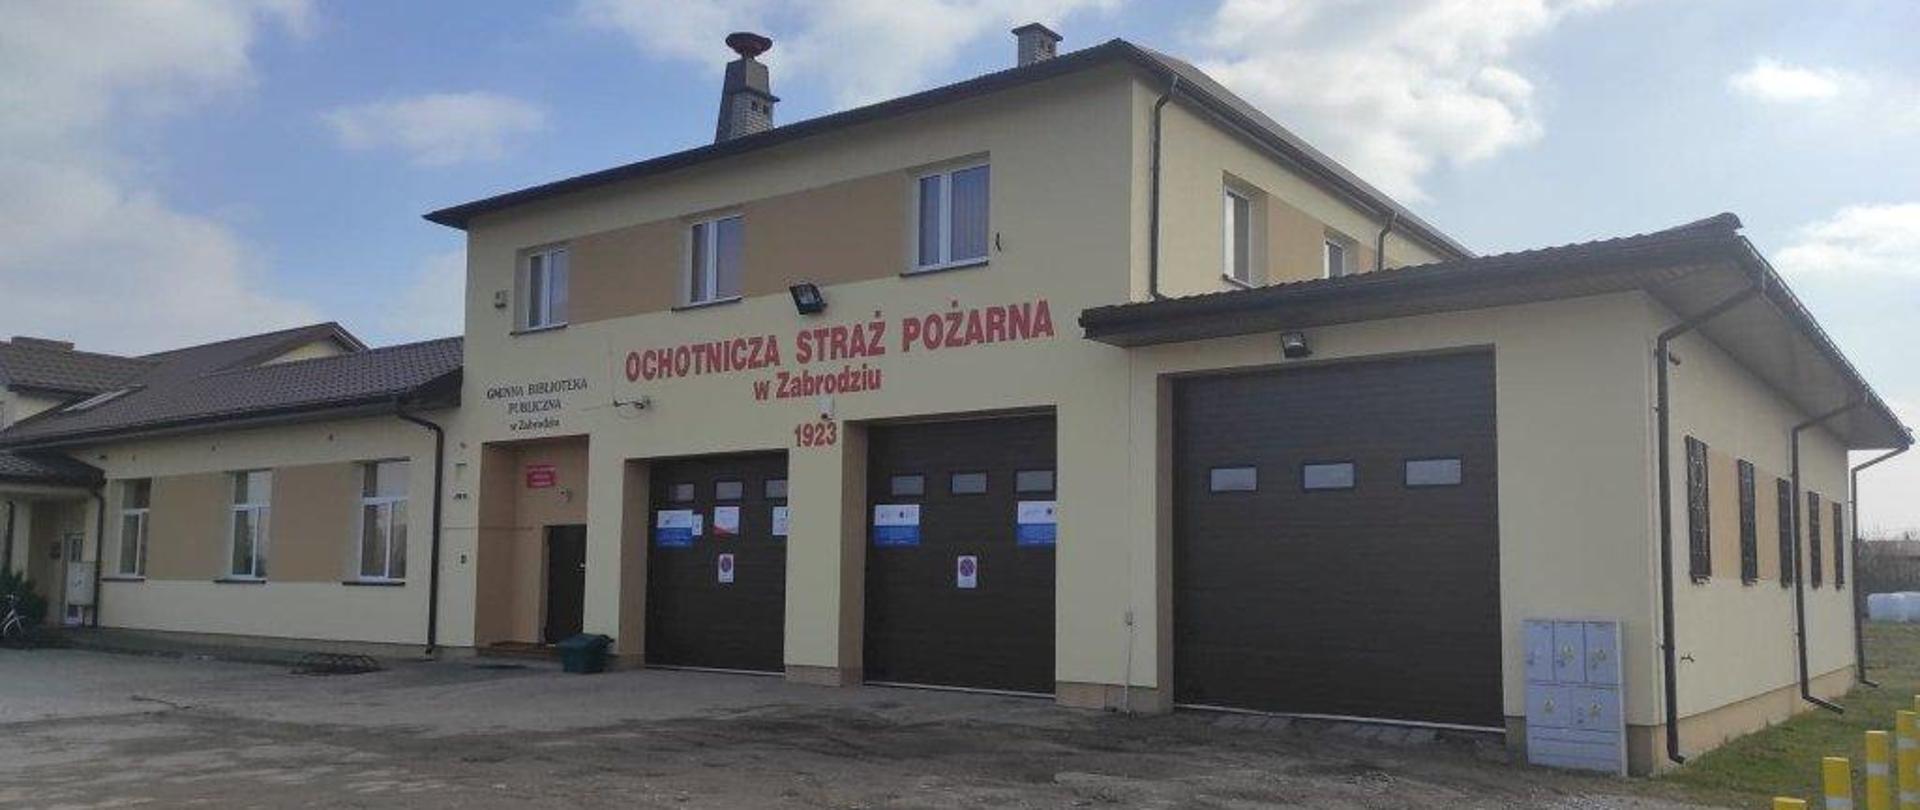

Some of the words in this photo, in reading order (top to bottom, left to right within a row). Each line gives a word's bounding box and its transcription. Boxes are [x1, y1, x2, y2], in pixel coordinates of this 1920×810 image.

[626, 335, 780, 382] OCHOTNICZA
[796, 310, 886, 364] STRAŻ
[902, 299, 1055, 352] POŻARNA
[528, 379, 588, 395] BIBLIOTEKA
[754, 381, 770, 400] w
[776, 363, 882, 399] Zabrodziu
[508, 399, 561, 414] PUBLICZNA
[795, 422, 837, 447] 1923
